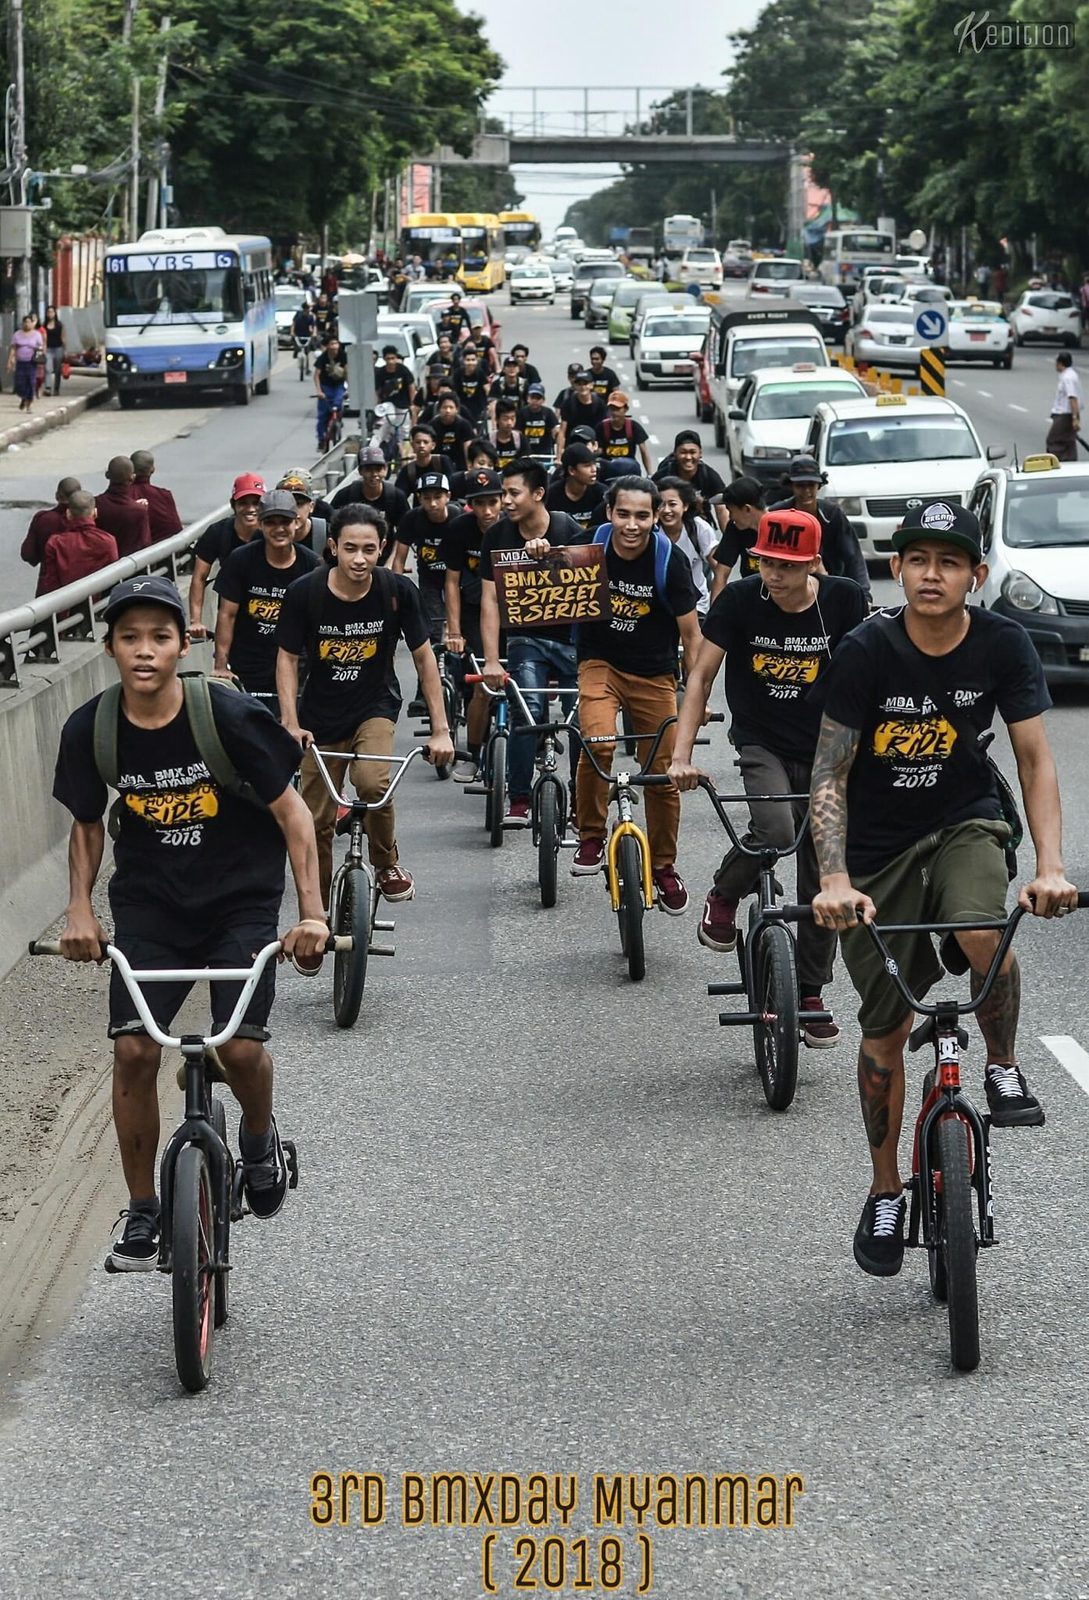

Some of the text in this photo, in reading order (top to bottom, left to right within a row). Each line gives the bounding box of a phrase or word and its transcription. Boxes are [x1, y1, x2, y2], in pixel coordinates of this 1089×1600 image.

[767, 520, 806, 549] TMT
[500, 551, 529, 561] MBA
[504, 563, 601, 588] BMX DAY
[520, 583, 602, 606] STREET
[505, 589, 522, 624] 2018
[523, 601, 601, 622] SERIES
[345, 622, 365, 632] BMX
[367, 620, 384, 629] DAY
[784, 637, 808, 645] BMX
[811, 634, 831, 645] DAY
[327, 646, 368, 661] RIDE
[332, 670, 359, 681] 2018
[762, 662, 812, 681] RIDE
[954, 690, 984, 702] DAY
[154, 767, 184, 781] BMX
[187, 760, 207, 776] DAY
[892, 772, 938, 789] 2018
[143, 796, 205, 823] RIDE
[160, 830, 202, 847] 2018
